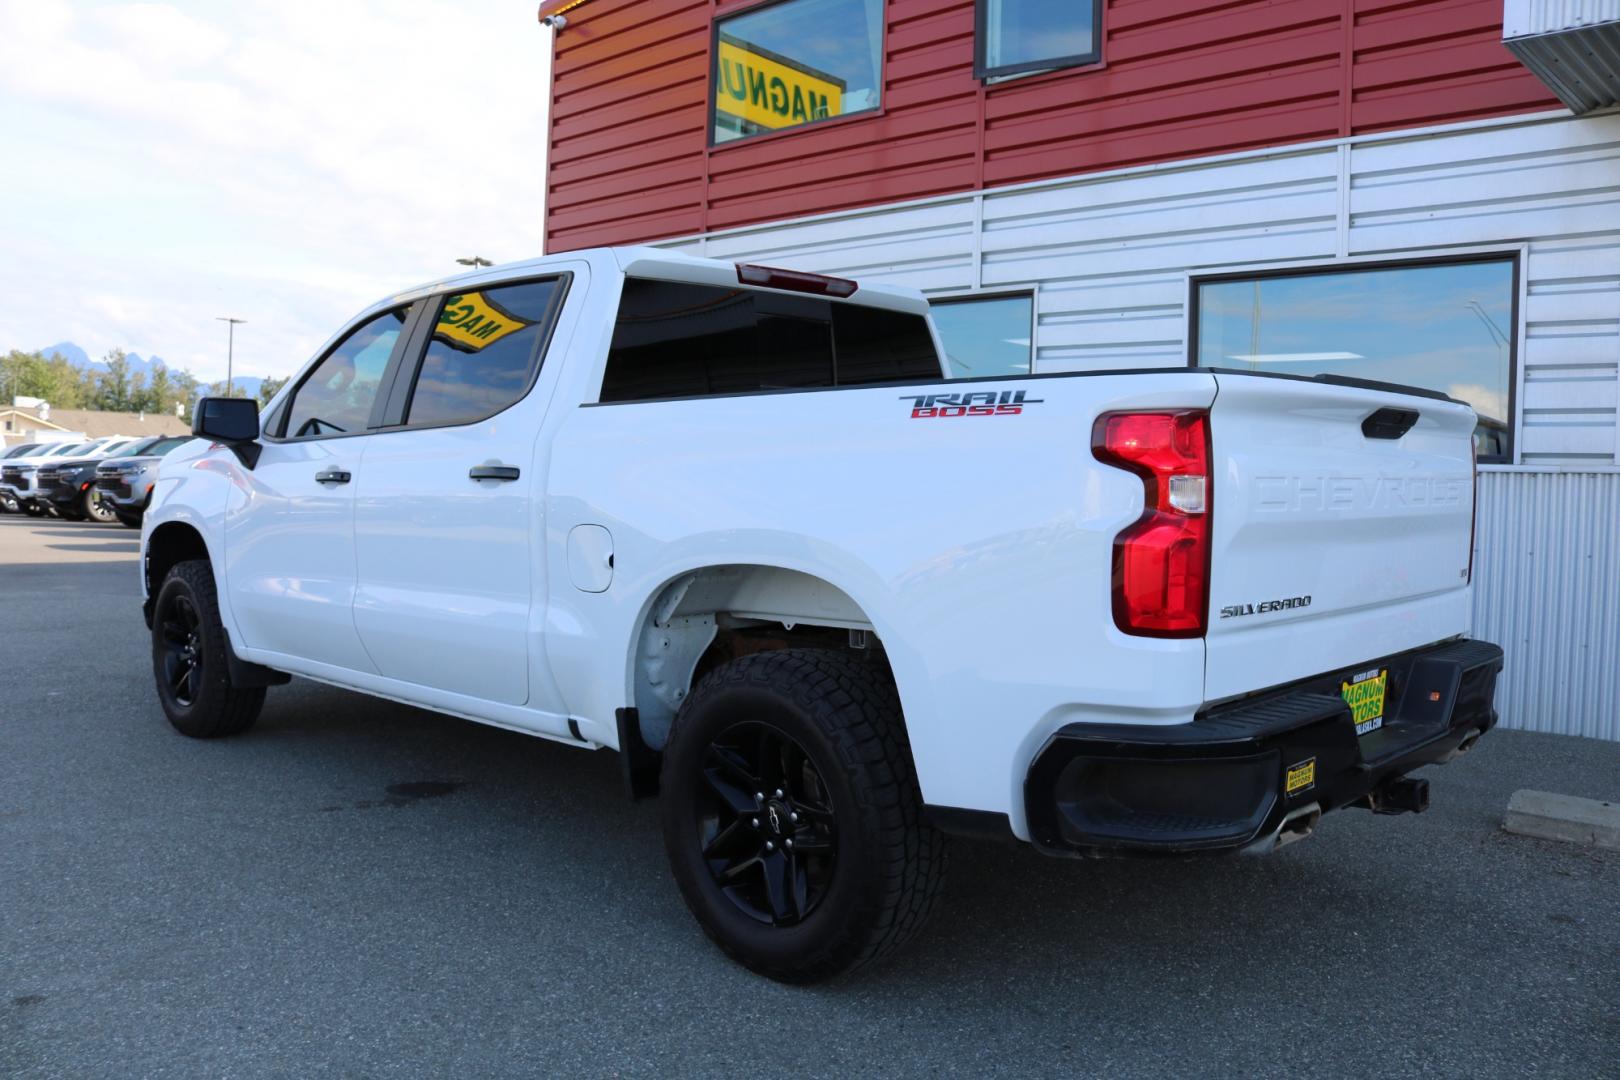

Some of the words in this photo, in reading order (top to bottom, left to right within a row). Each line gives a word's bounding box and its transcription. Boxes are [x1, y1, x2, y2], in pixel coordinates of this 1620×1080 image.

[898, 390, 1045, 408] TRAIL
[910, 403, 1024, 419] BOSS
[1220, 595, 1312, 619] SILVERADO
